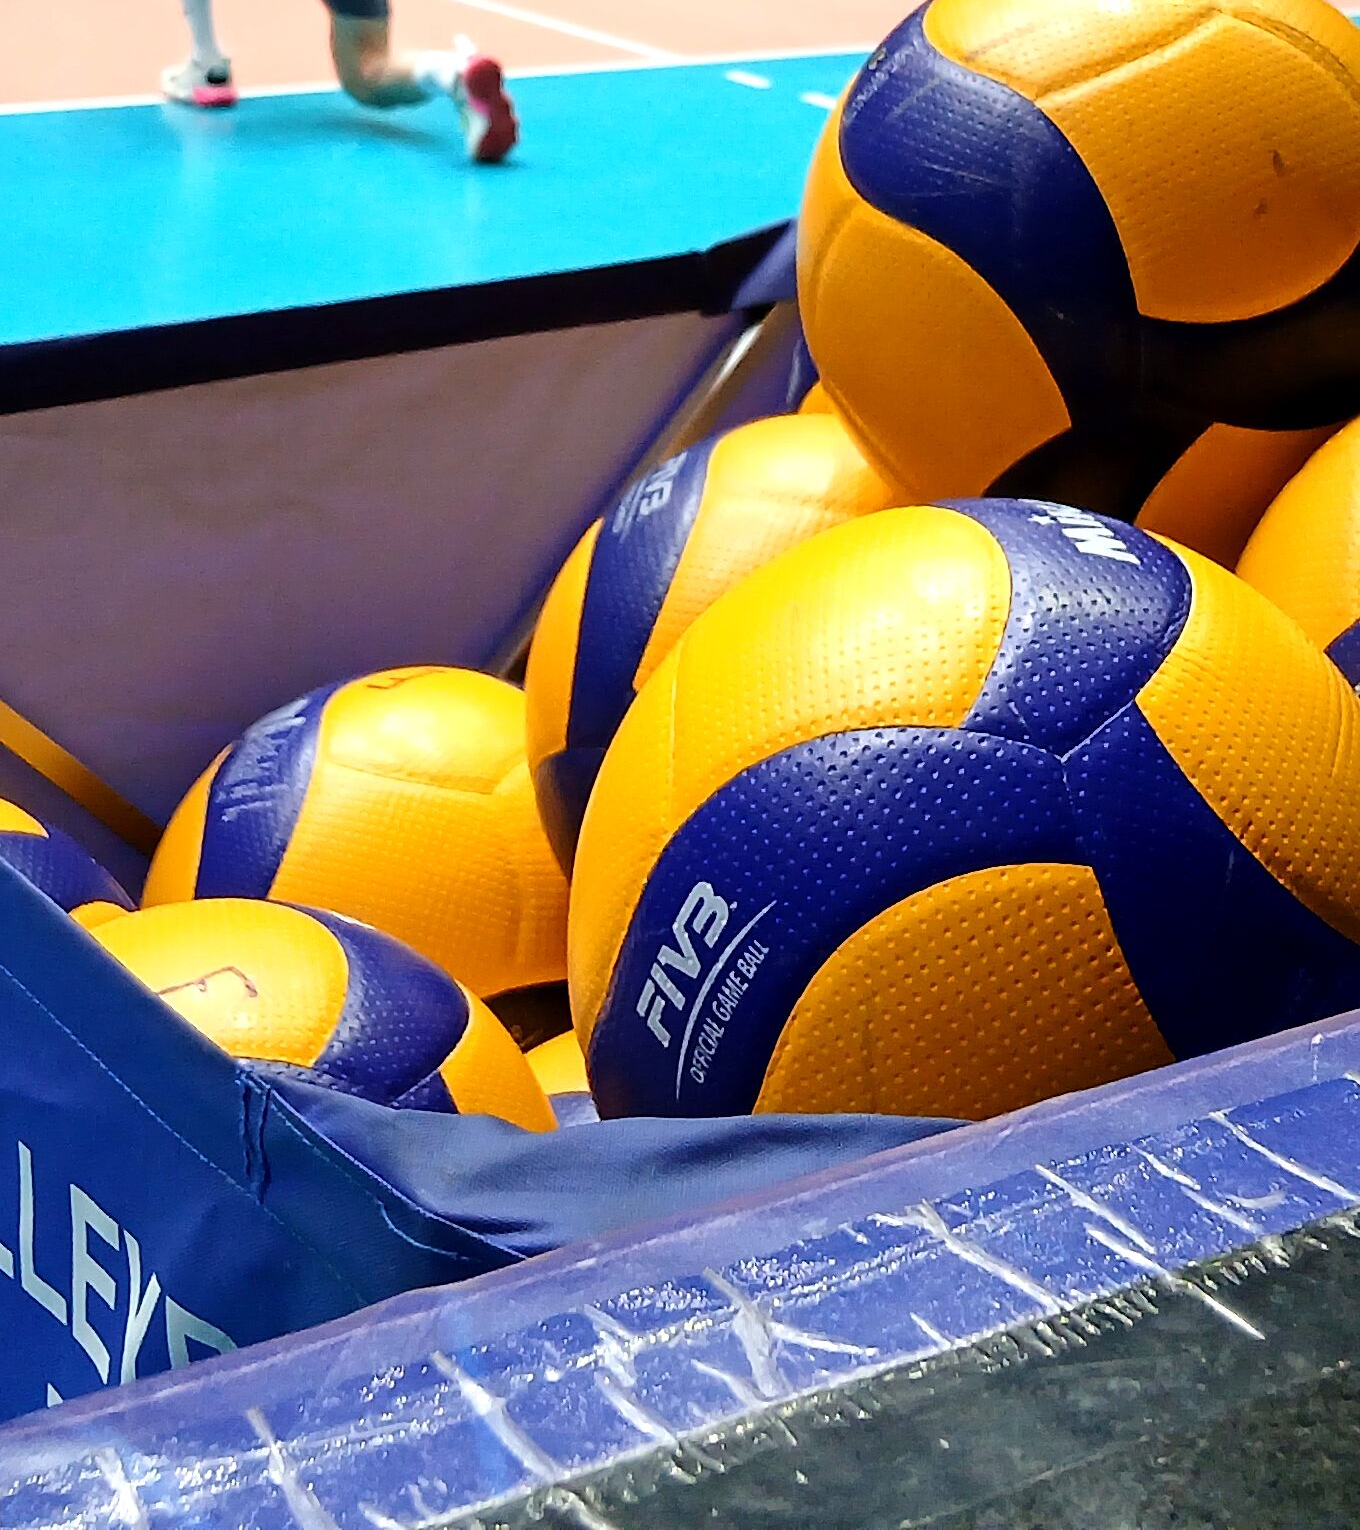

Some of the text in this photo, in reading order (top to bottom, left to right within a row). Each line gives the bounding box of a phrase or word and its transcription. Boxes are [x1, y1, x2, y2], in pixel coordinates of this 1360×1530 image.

[636, 881, 730, 1048] FIVB
[690, 939, 770, 1084] OFFICIAL GAME BALL
